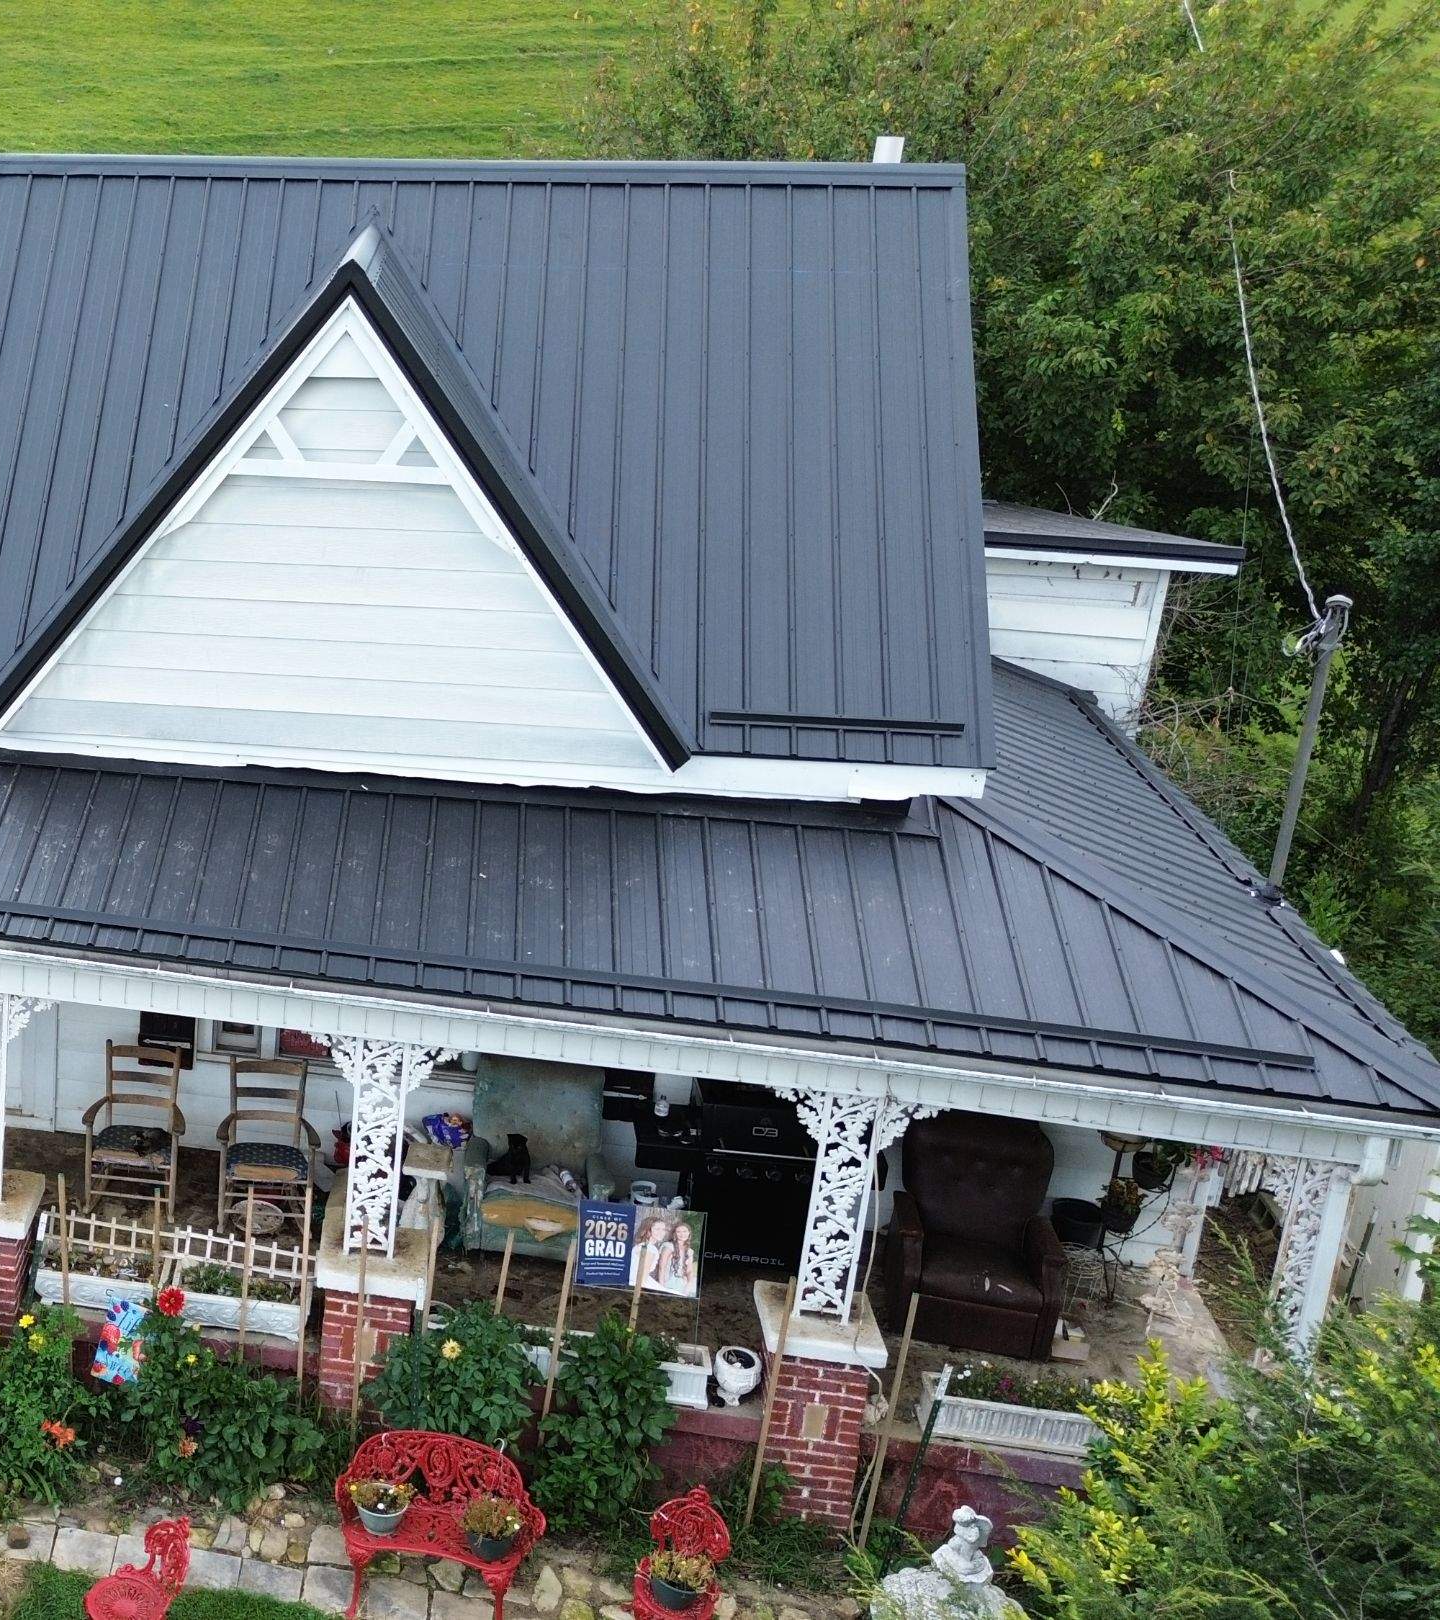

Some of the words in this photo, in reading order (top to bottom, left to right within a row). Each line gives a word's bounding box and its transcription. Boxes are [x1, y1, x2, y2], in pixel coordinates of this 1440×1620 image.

[584, 1219, 629, 1241] 2026
[584, 1239, 626, 1258] GRAD
[704, 1252, 785, 1266] CHARBROIL
